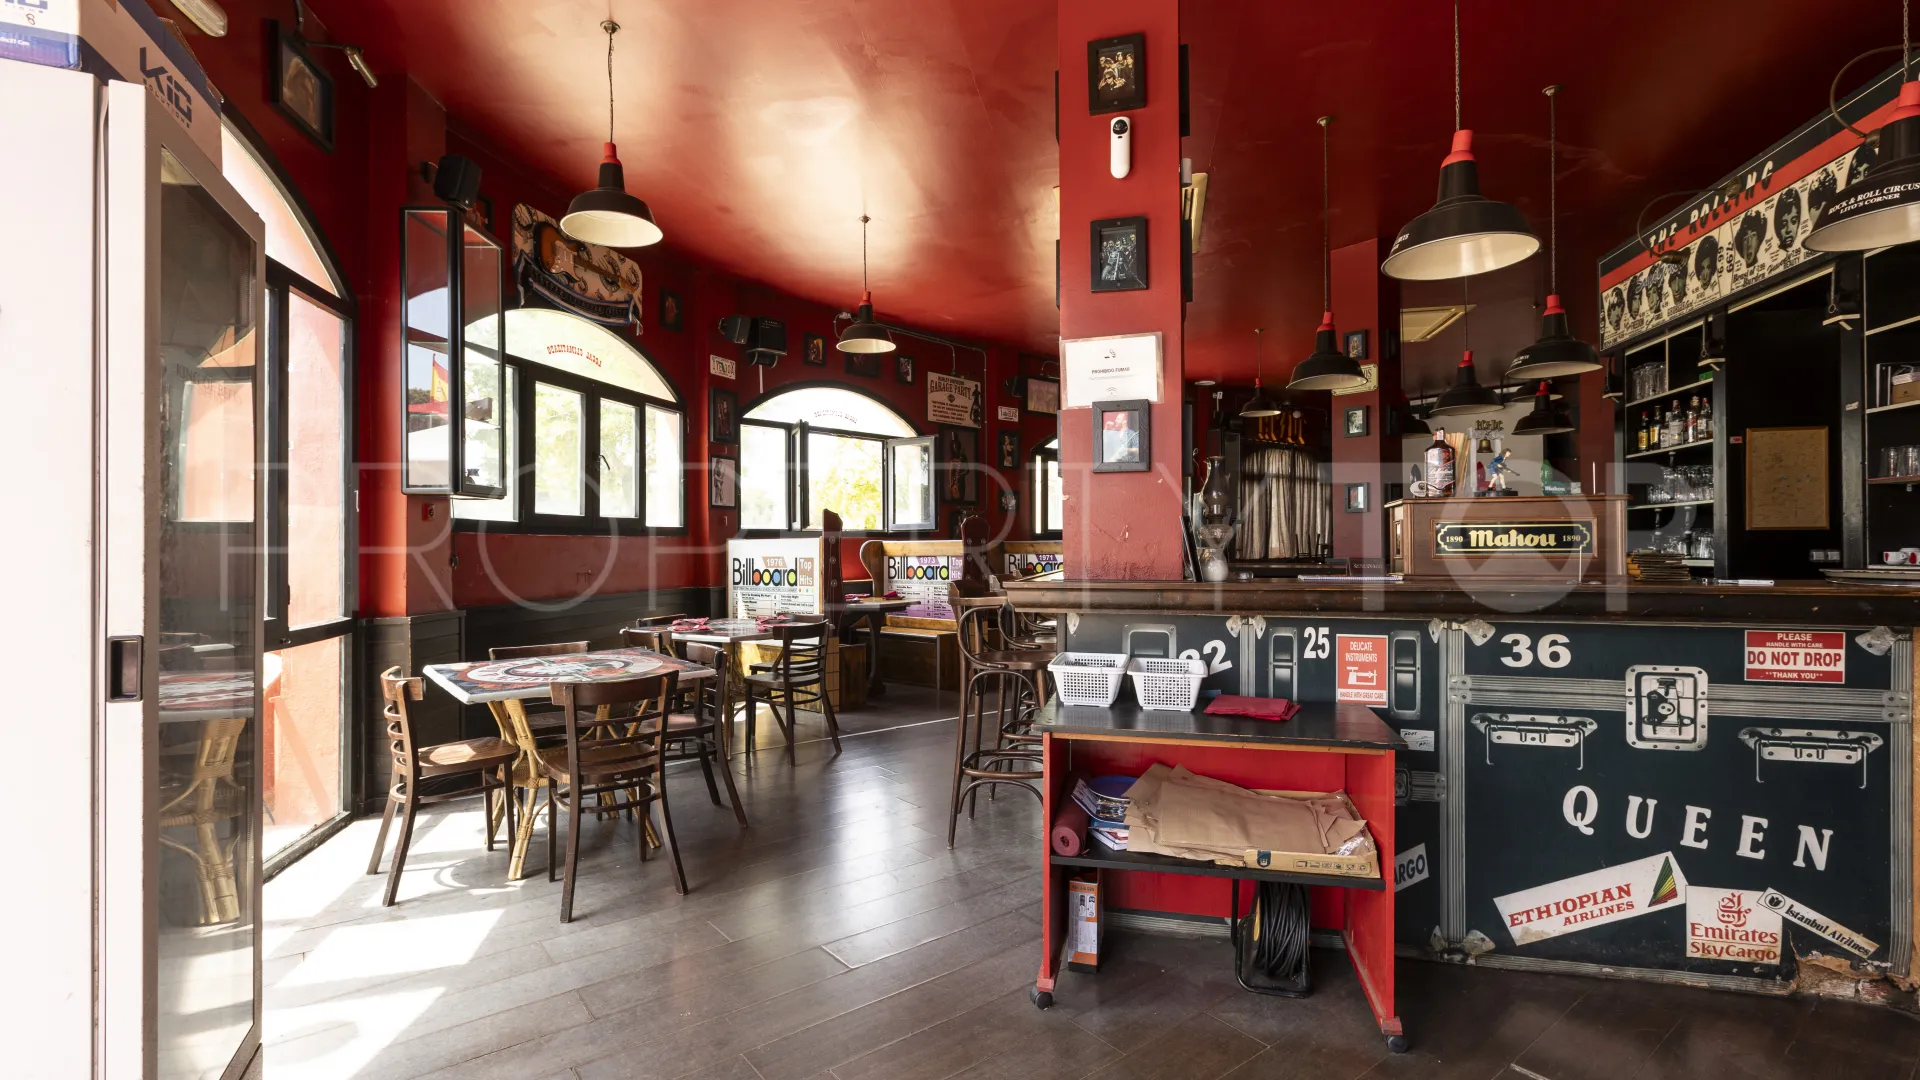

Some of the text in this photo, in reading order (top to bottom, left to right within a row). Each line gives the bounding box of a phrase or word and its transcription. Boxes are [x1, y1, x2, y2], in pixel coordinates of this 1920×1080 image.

[1828, 182, 1920, 215] ROCK & ROLL CIRCUS
[1864, 193, 1900, 205] CORNER
[1648, 222, 1678, 258] THE
[929, 379, 972, 401] GARAGE PARTY
[1446, 528, 1581, 547] 1890 Mahou 1890
[733, 557, 797, 586] Billboard
[766, 558, 783, 567] 1976
[799, 559, 812, 571] Top
[888, 556, 949, 580] Billboard
[951, 557, 963, 567] Top
[799, 575, 813, 586] Hits
[1304, 626, 1330, 660] 25
[1350, 641, 1373, 651] DELICATE
[1777, 633, 1813, 641] PLEASE
[1345, 652, 1378, 663] INSTRUMENTS
[1500, 633, 1572, 669] 36
[1747, 650, 1842, 667] DO NOT DROP
[1340, 691, 1354, 699] HANDLE
[1362, 692, 1374, 700] GREAT
[1374, 692, 1384, 700] CARE
[1563, 785, 1834, 871] QUEEN
[1508, 883, 1633, 928] ETHIOPIAN
[1563, 900, 1635, 927] AIRLINES
[1690, 922, 1778, 945] Emirates
[1828, 930, 1871, 956] Airlines
[1690, 941, 1778, 962] SkyCargo
